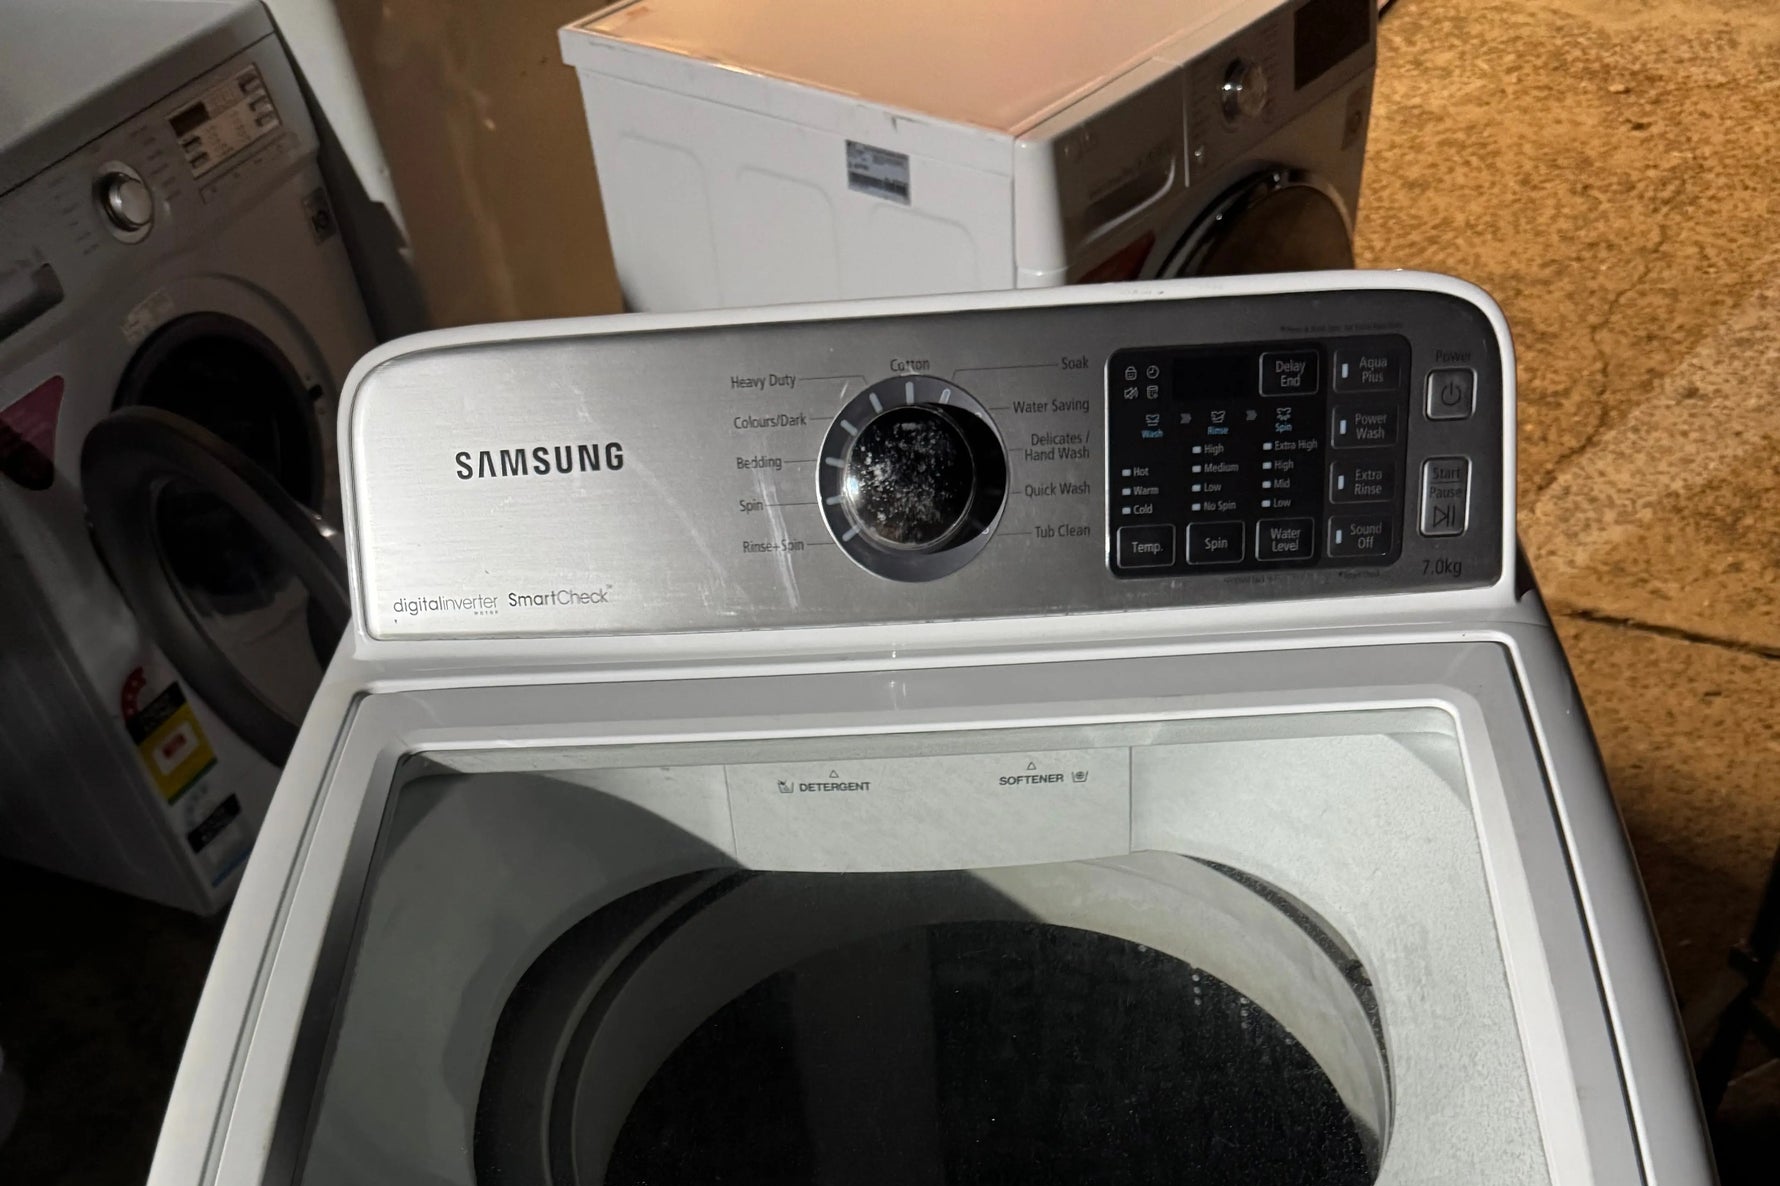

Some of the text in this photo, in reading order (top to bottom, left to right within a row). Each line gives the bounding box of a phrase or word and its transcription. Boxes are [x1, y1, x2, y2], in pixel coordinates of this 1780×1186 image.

[1061, 357, 1089, 370] Soak
[1359, 356, 1388, 371] Aqua
[1435, 350, 1472, 363] Power
[1275, 359, 1306, 376] Delay
[730, 373, 796, 391] Heavy Duty
[1280, 373, 1301, 388] End
[1361, 371, 1384, 384] Plus
[1012, 399, 1090, 415] Water Saving
[733, 411, 807, 430] Colours/Dark
[1354, 413, 1387, 425] Power
[1141, 428, 1164, 438] Wash
[1207, 425, 1229, 436] Rinse
[1275, 422, 1293, 433] Spin
[1356, 426, 1385, 440] Wash
[1030, 432, 1082, 446] Delicates
[1274, 438, 1318, 452] Extra High
[1024, 446, 1090, 461] Hand Wash
[1204, 443, 1224, 456] High
[455, 441, 624, 480] SAMSUNG
[736, 455, 782, 471] Bedding
[1204, 462, 1239, 473] Medium
[1274, 460, 1294, 471] High
[1133, 467, 1149, 476] Hot
[1355, 469, 1383, 481] Extra
[1432, 466, 1462, 480] Start
[1024, 482, 1091, 498] Quick Wash
[1204, 482, 1222, 492] Low
[1274, 478, 1291, 489] Mid
[1354, 483, 1383, 496] Rinse
[1133, 486, 1159, 496] Warm
[1429, 485, 1463, 499] Pause
[739, 498, 764, 515] Spin
[1133, 504, 1153, 514] Cold
[1204, 499, 1237, 512] No Spin
[1273, 498, 1291, 508] Low
[1034, 524, 1091, 539] Tub Clean
[1270, 526, 1301, 542] Water
[1350, 521, 1383, 536] Sound
[742, 538, 805, 553] Rinse+Spin
[1131, 540, 1164, 556] Temp.
[1204, 537, 1228, 553] Spin
[1271, 538, 1299, 553] Level
[1357, 536, 1374, 549] Off
[1422, 558, 1462, 578] 7.0kg
[393, 592, 498, 616] digitalinverter
[999, 773, 1064, 786] SOFTENER
[799, 781, 871, 793] DETERGENT
